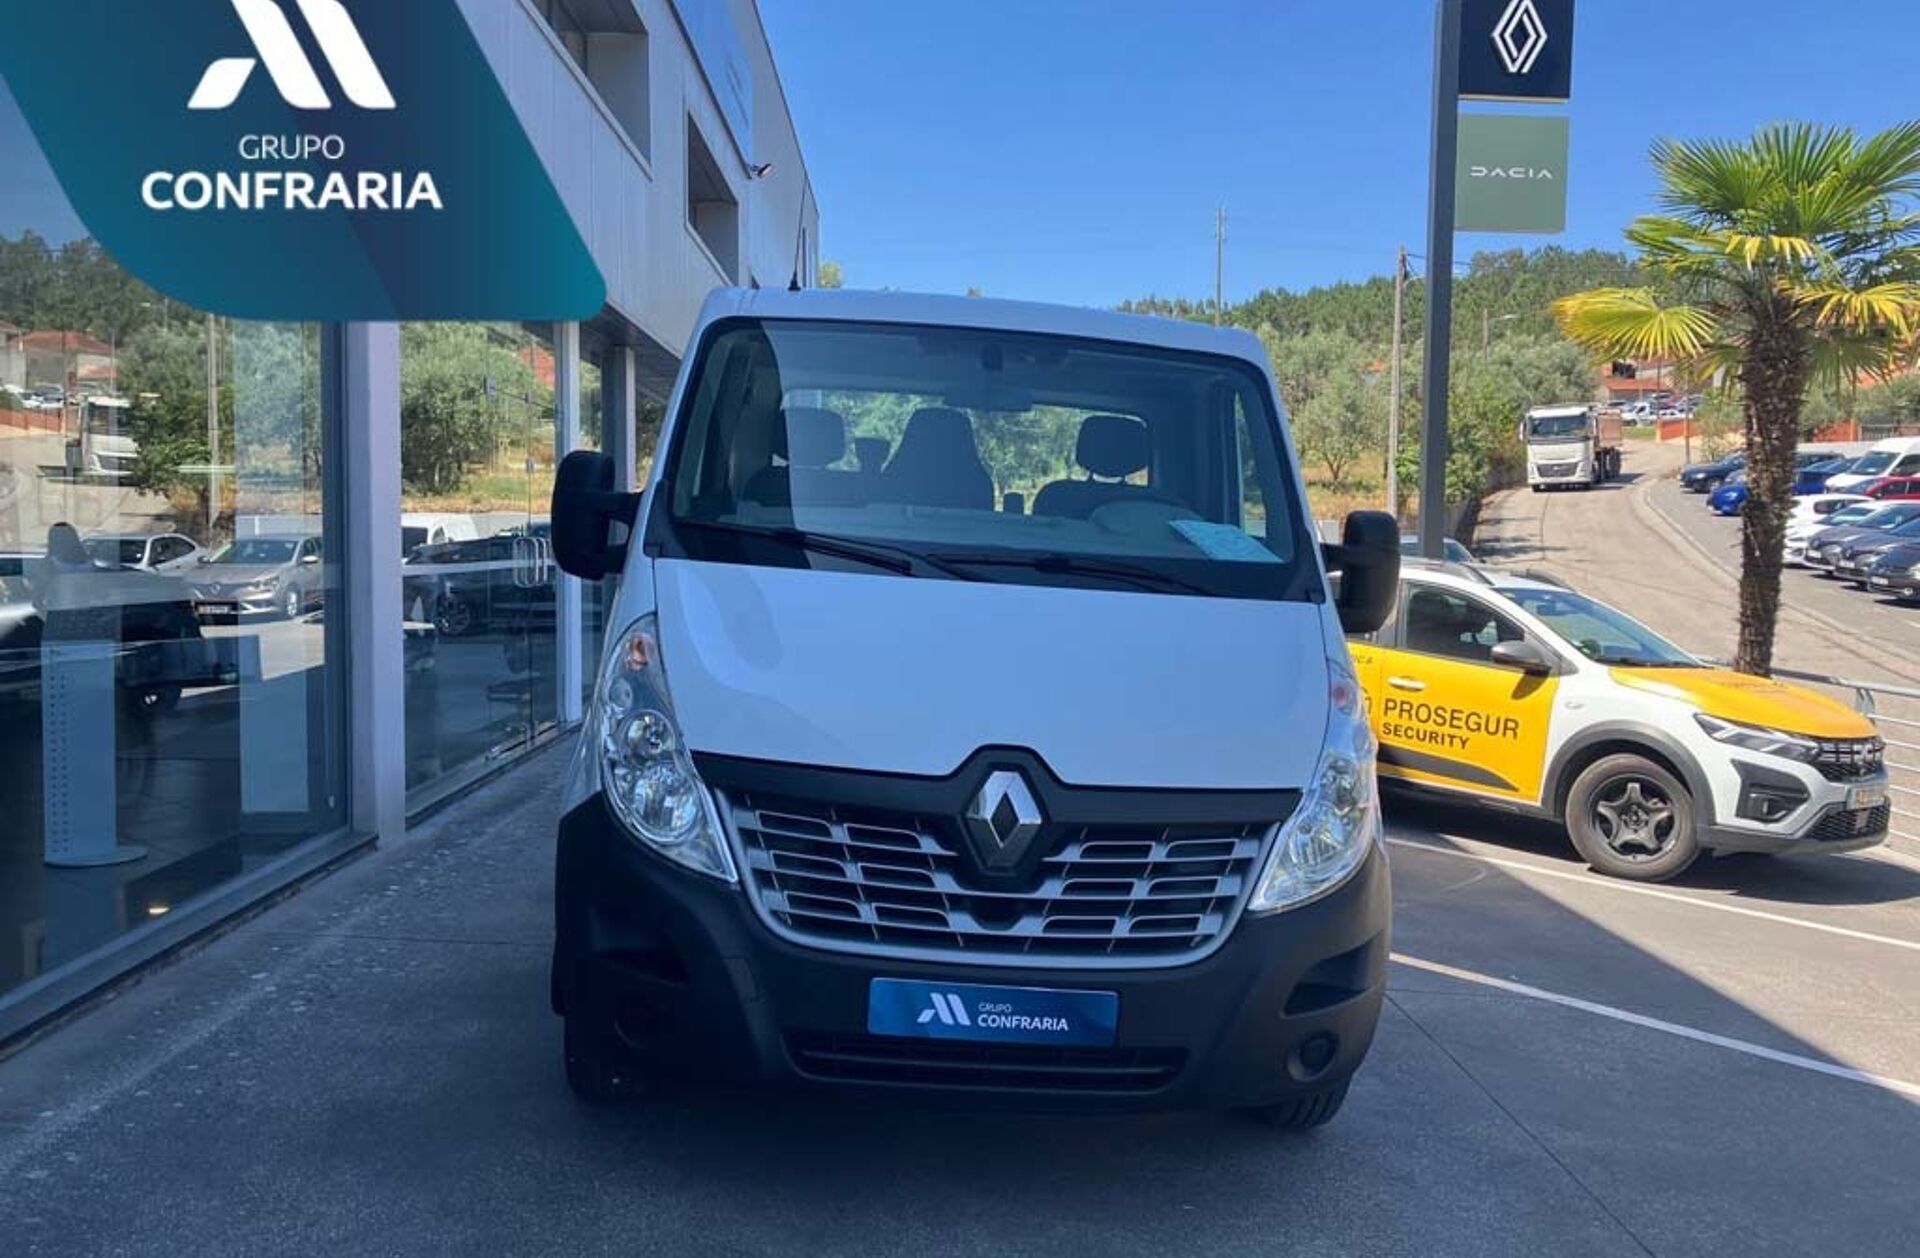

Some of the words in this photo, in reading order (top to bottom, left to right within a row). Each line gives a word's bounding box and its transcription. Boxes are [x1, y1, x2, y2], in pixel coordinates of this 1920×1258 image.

[1470, 166, 1553, 179] DACIA
[1384, 698, 1520, 739] PROSEGUR
[1382, 722, 1470, 749] SECURITY
[978, 1003, 1012, 1012] GRUPO
[977, 1014, 1068, 1031] CONFRARIA
